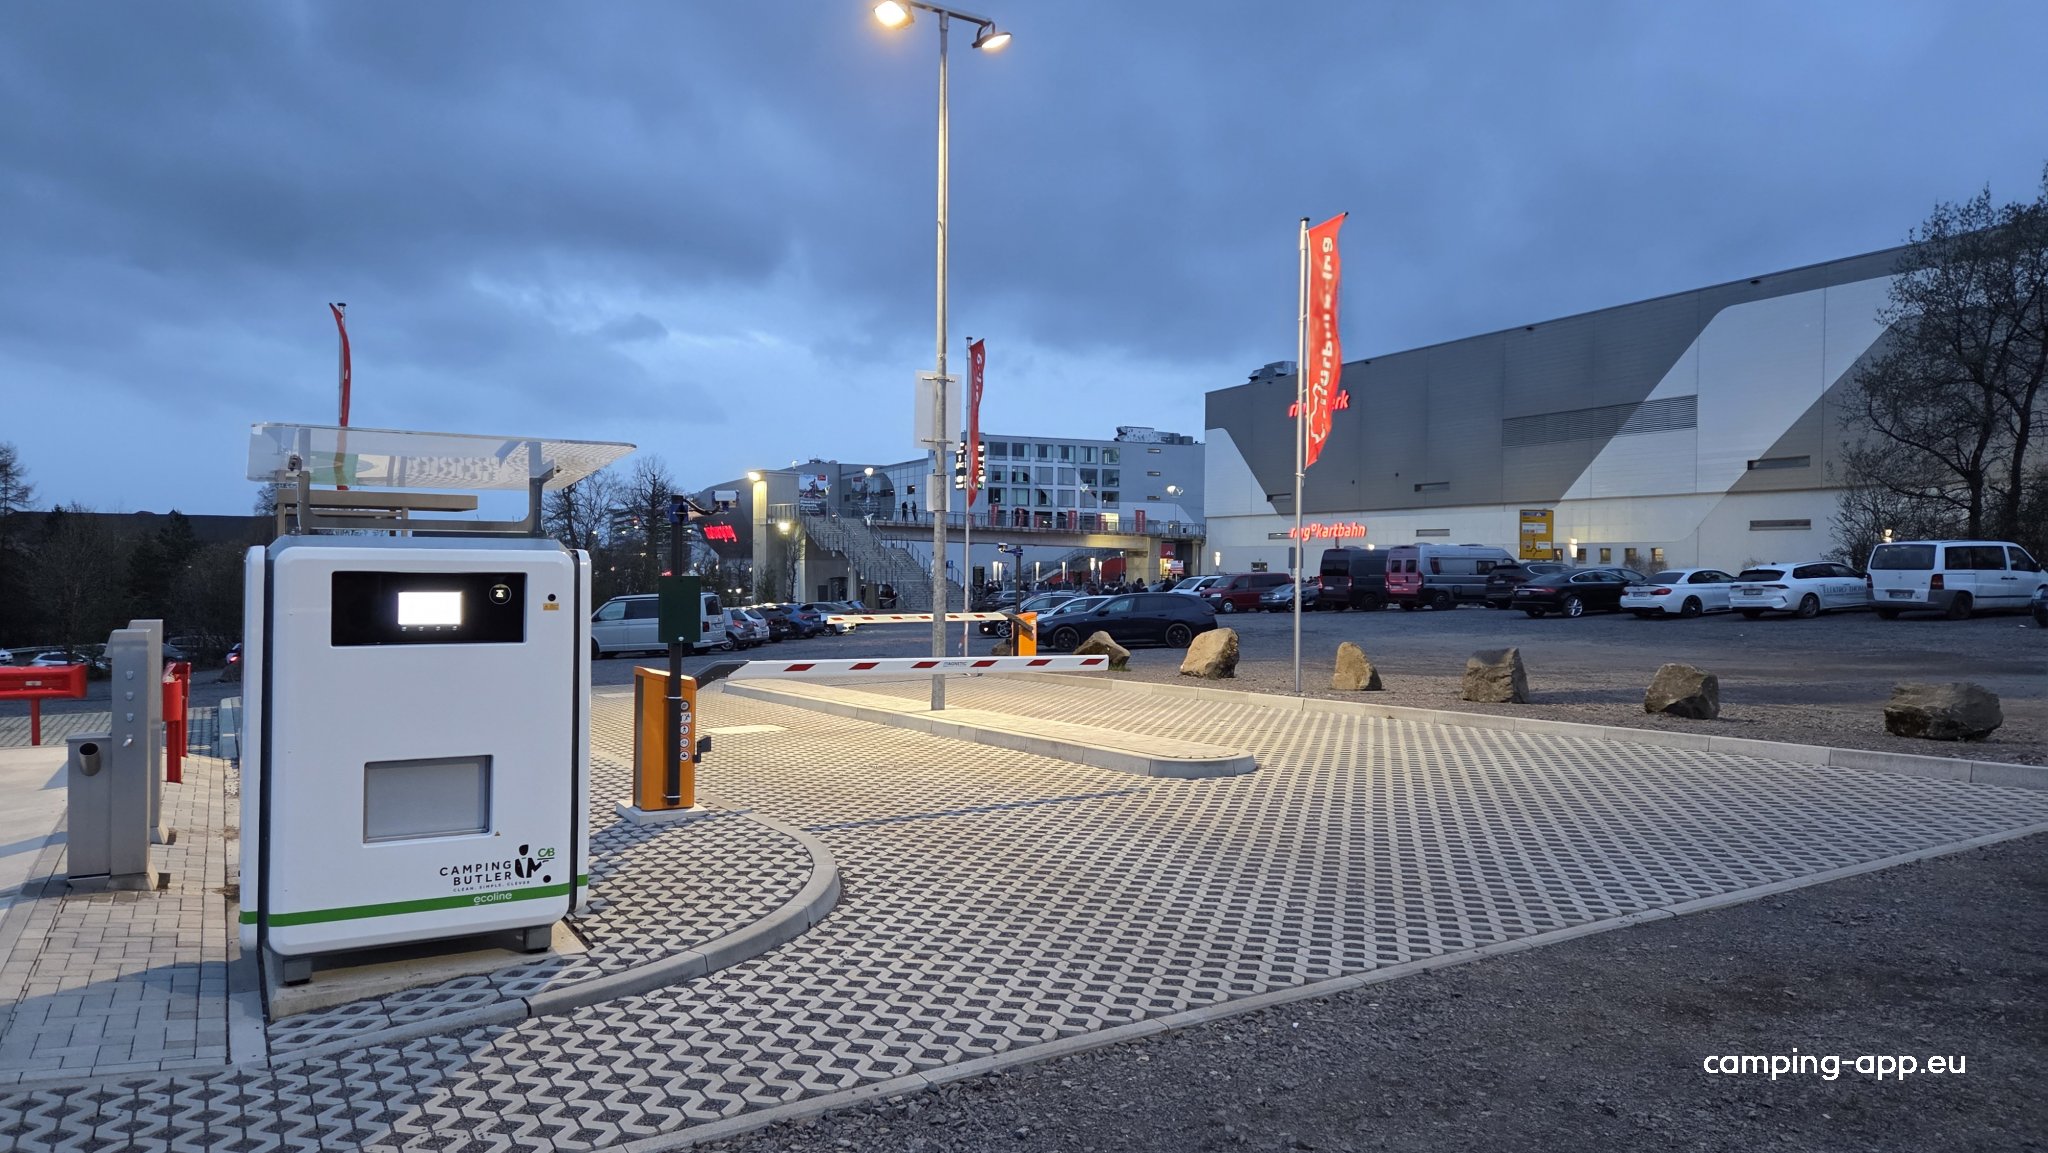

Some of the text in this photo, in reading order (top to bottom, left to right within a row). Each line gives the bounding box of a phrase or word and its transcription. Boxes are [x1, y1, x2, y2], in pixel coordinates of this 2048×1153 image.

[439, 860, 512, 877] CAMPING
[453, 871, 512, 887] BUTLER
[473, 892, 513, 906] ecoline
